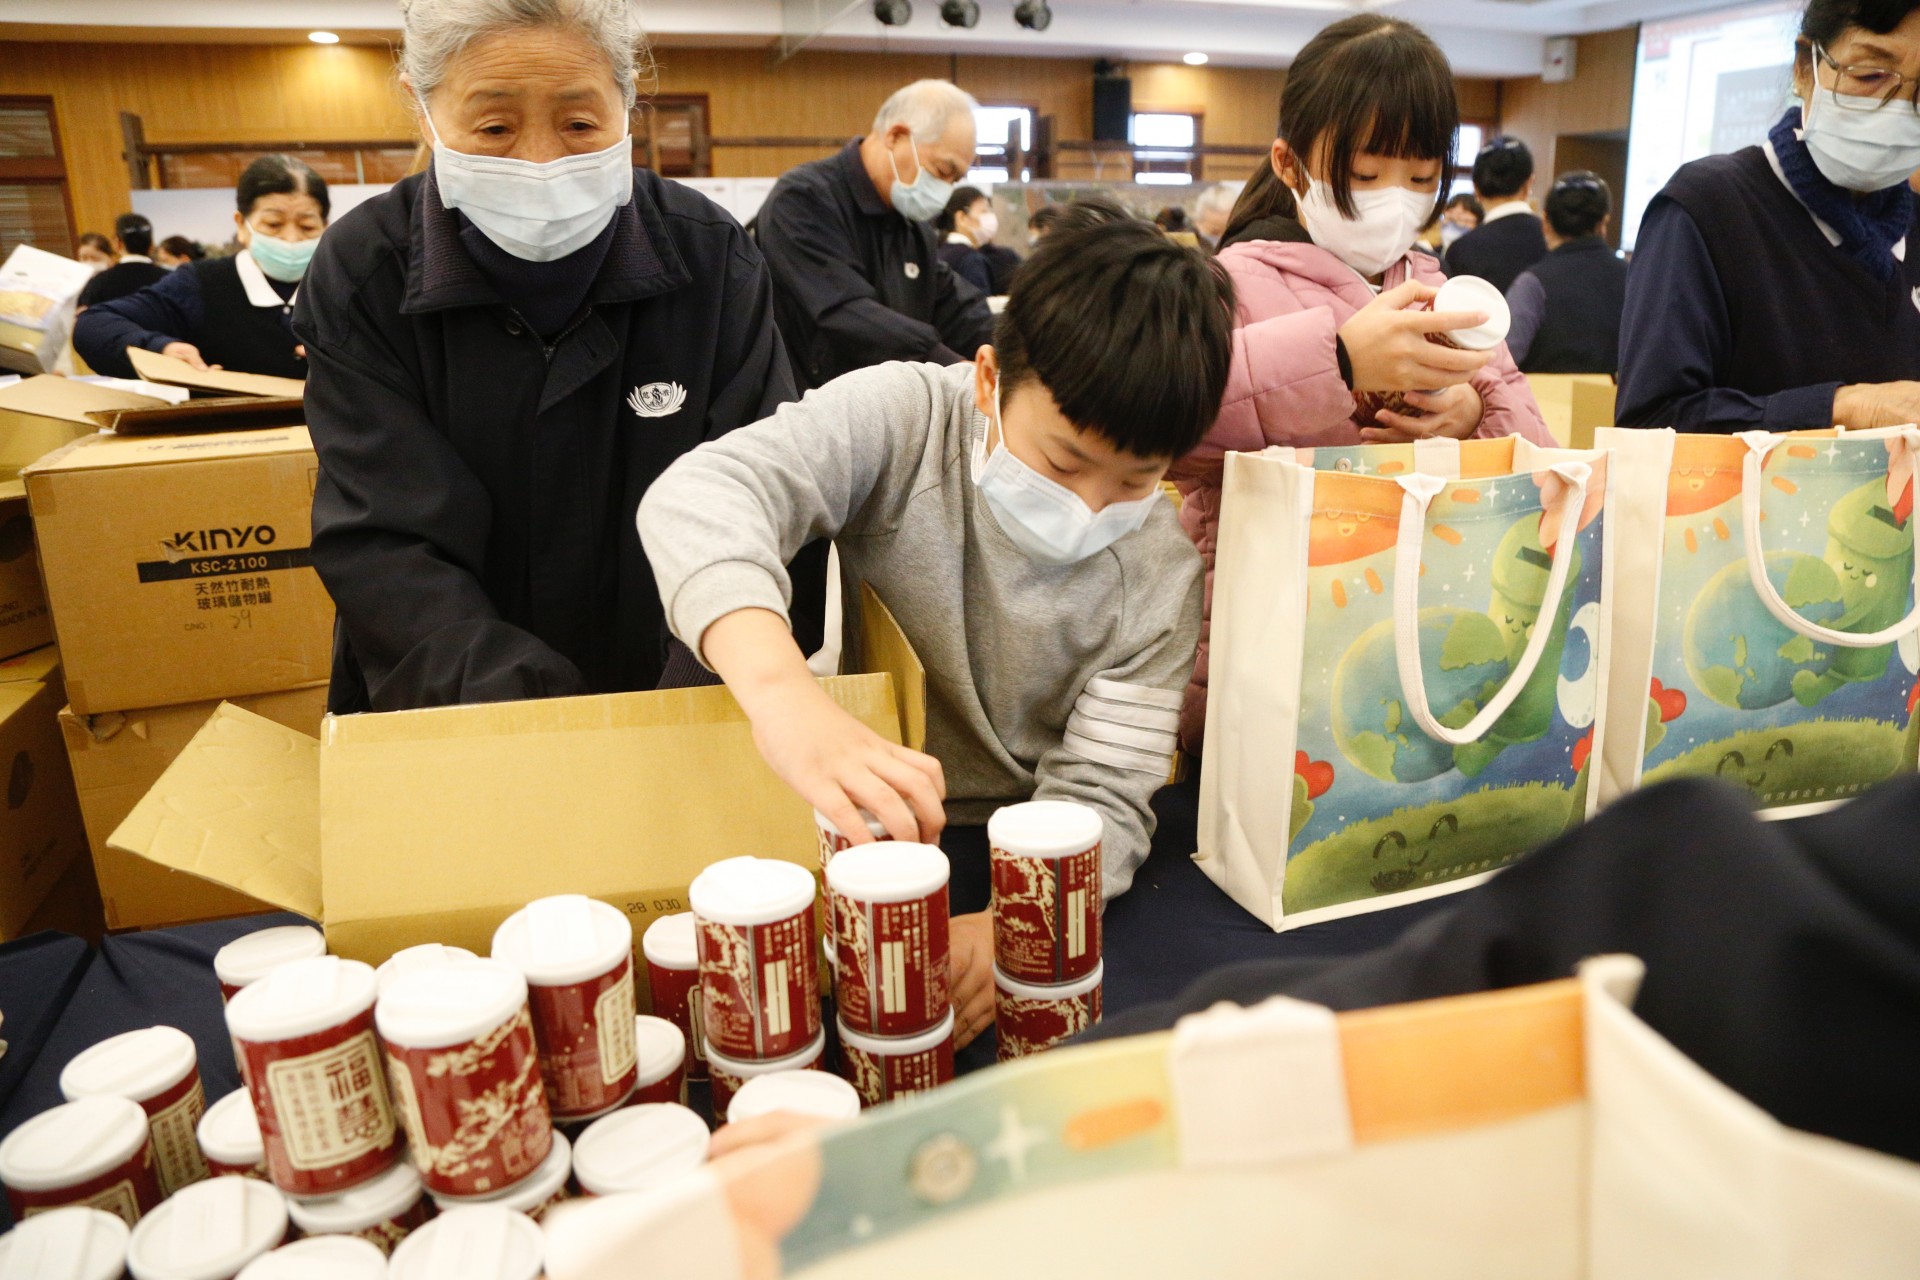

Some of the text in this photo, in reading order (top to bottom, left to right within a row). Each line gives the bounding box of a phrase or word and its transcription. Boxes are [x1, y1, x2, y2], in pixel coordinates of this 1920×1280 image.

[175, 525, 276, 551] KINYO
[190, 556, 268, 575] KSC-2100
[195, 576, 270, 596] 天然竹耐熱
[197, 590, 273, 611] 玻璃儲物罐
